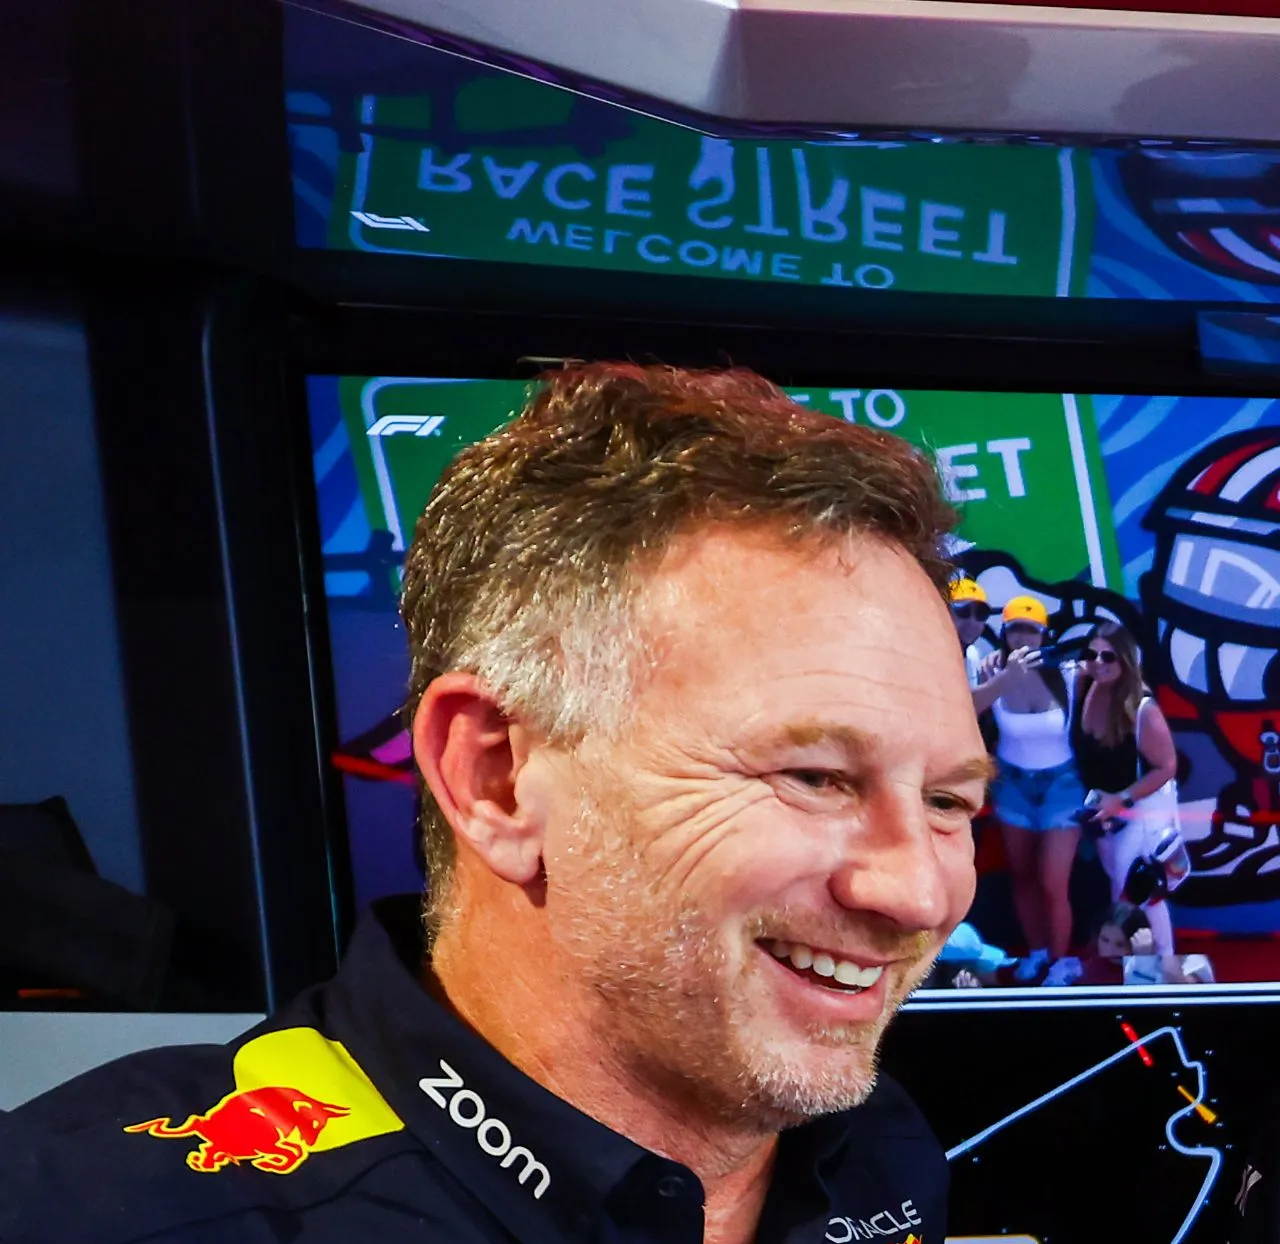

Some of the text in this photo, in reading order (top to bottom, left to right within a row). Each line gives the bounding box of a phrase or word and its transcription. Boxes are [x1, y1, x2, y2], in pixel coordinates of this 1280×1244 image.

[829, 389, 906, 428] TO
[419, 1059, 552, 1199] zoom
[825, 1200, 922, 1243] ORACLE
